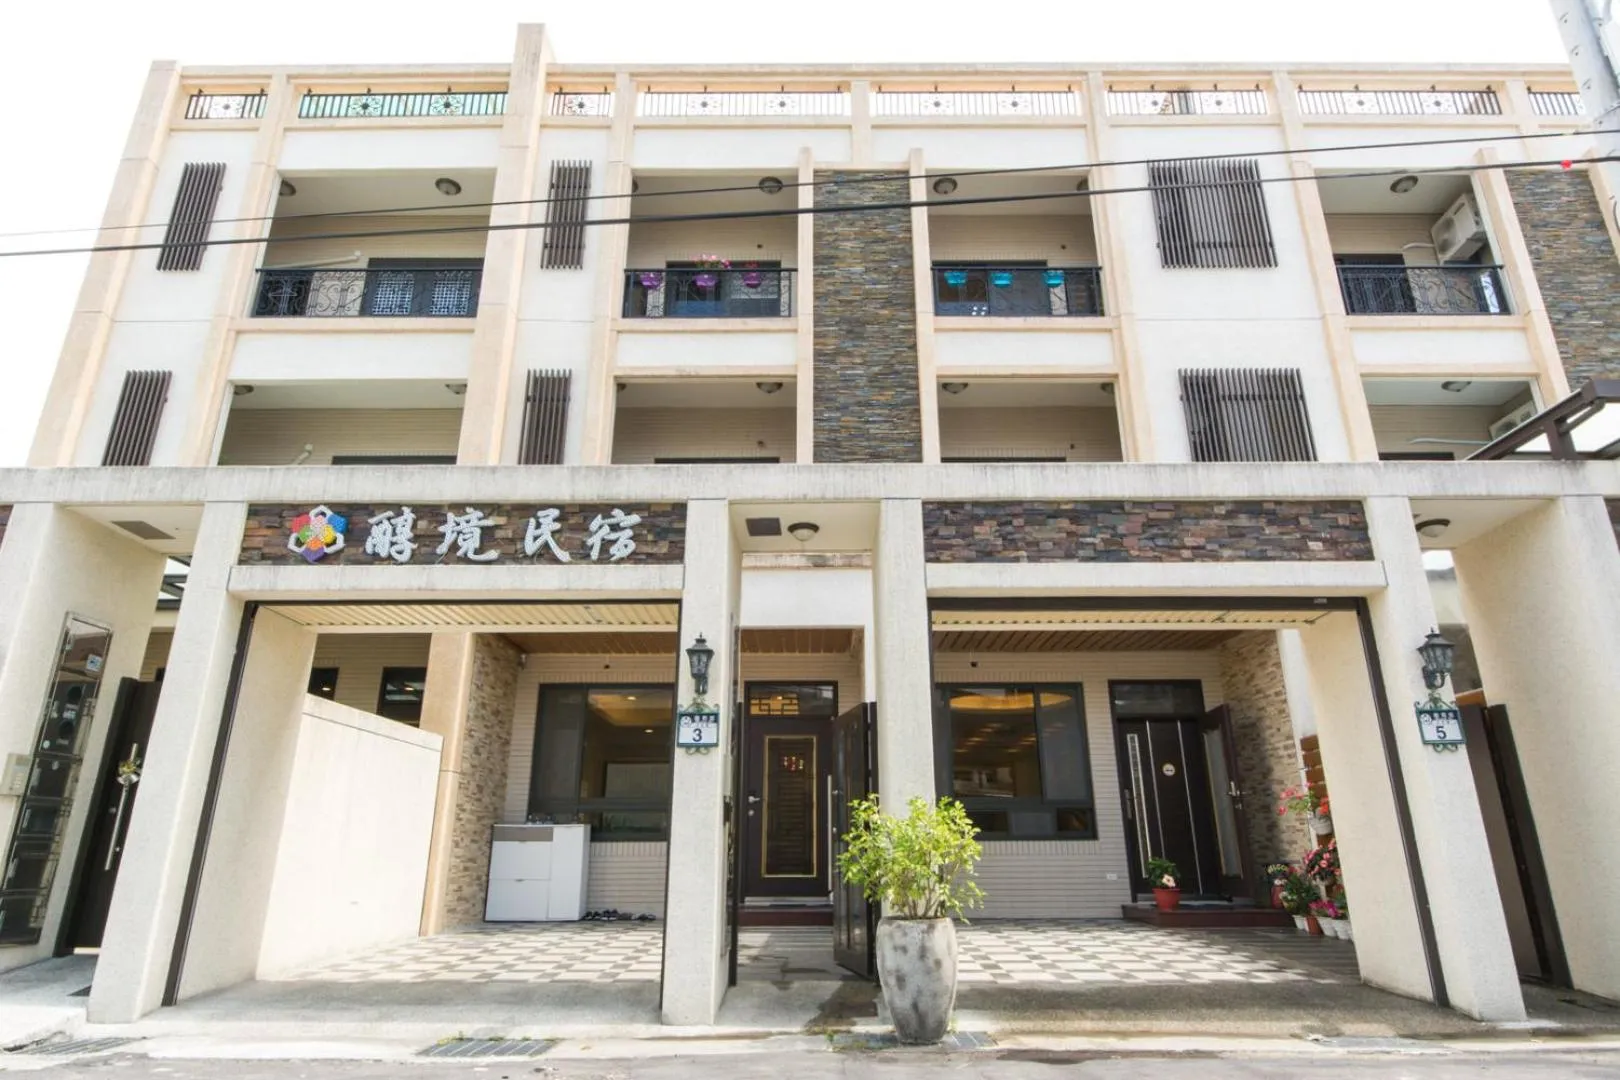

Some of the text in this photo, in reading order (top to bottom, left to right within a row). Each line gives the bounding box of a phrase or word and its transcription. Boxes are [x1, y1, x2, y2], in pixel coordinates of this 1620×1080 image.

[365, 505, 641, 563] 醇境民宿
[692, 728, 702, 742] 3
[1435, 726, 1447, 740] 5
